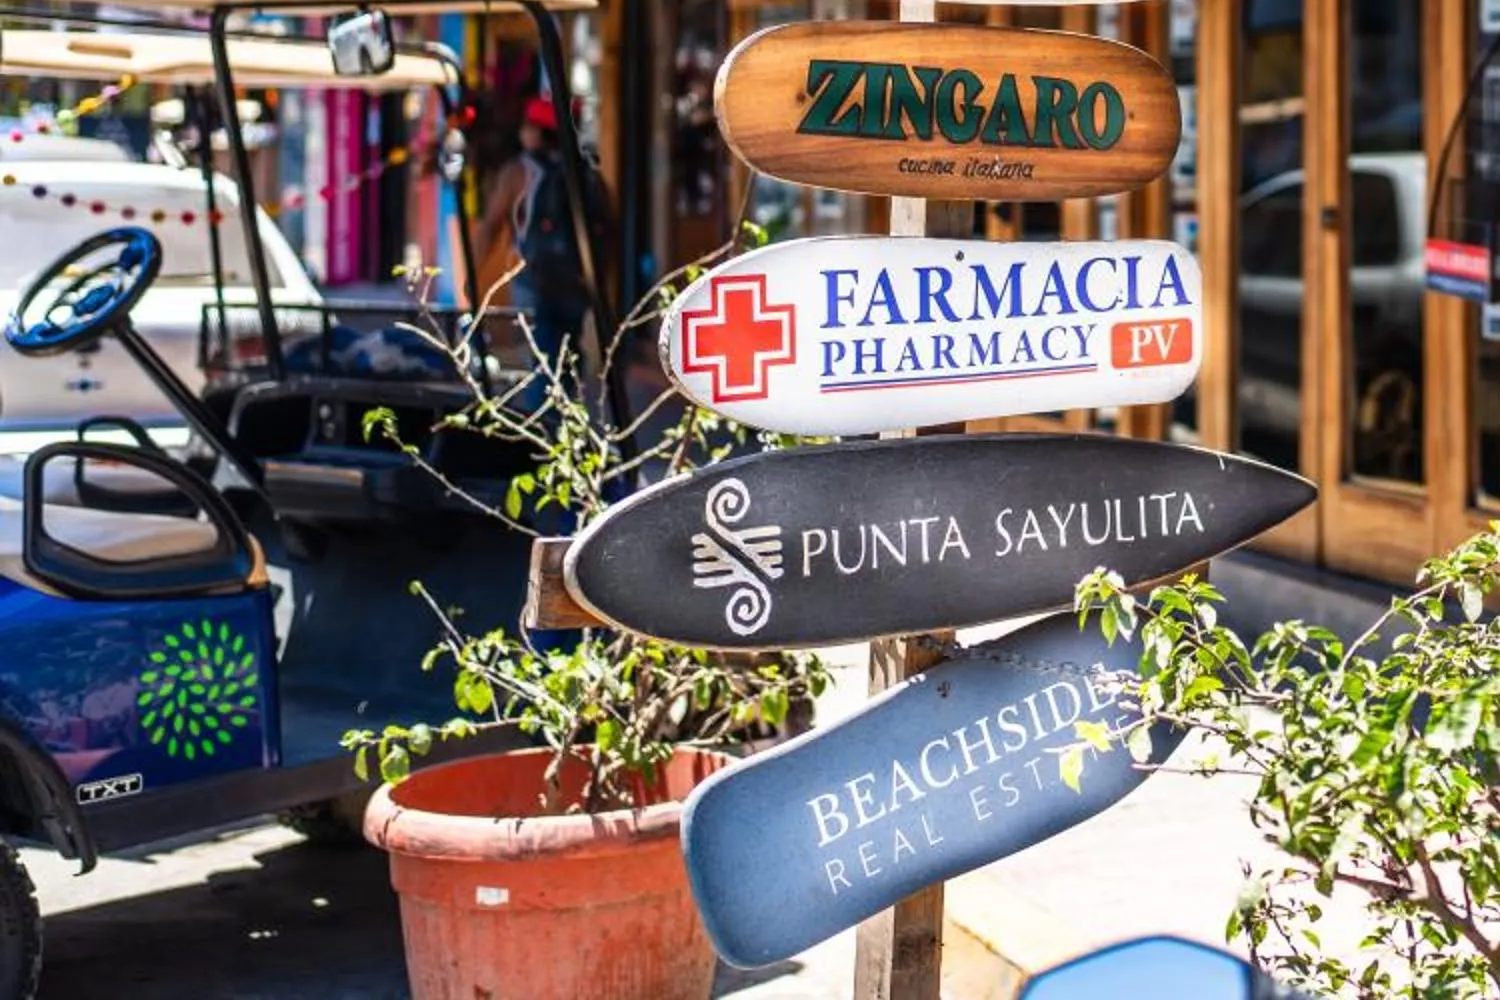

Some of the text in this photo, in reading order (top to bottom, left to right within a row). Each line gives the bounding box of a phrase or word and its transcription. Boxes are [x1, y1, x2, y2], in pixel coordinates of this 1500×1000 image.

[796, 59, 1126, 150] ZINGARO
[897, 155, 1035, 180] cucina italiana
[819, 252, 1193, 329] FARMACIA
[820, 323, 1180, 378] PHARMACY PV
[800, 491, 1205, 578] PUNTA SAYULITA
[82, 776, 139, 801] TXT
[807, 674, 1117, 848] BEACHSIDE
[824, 813, 944, 895] REAL
